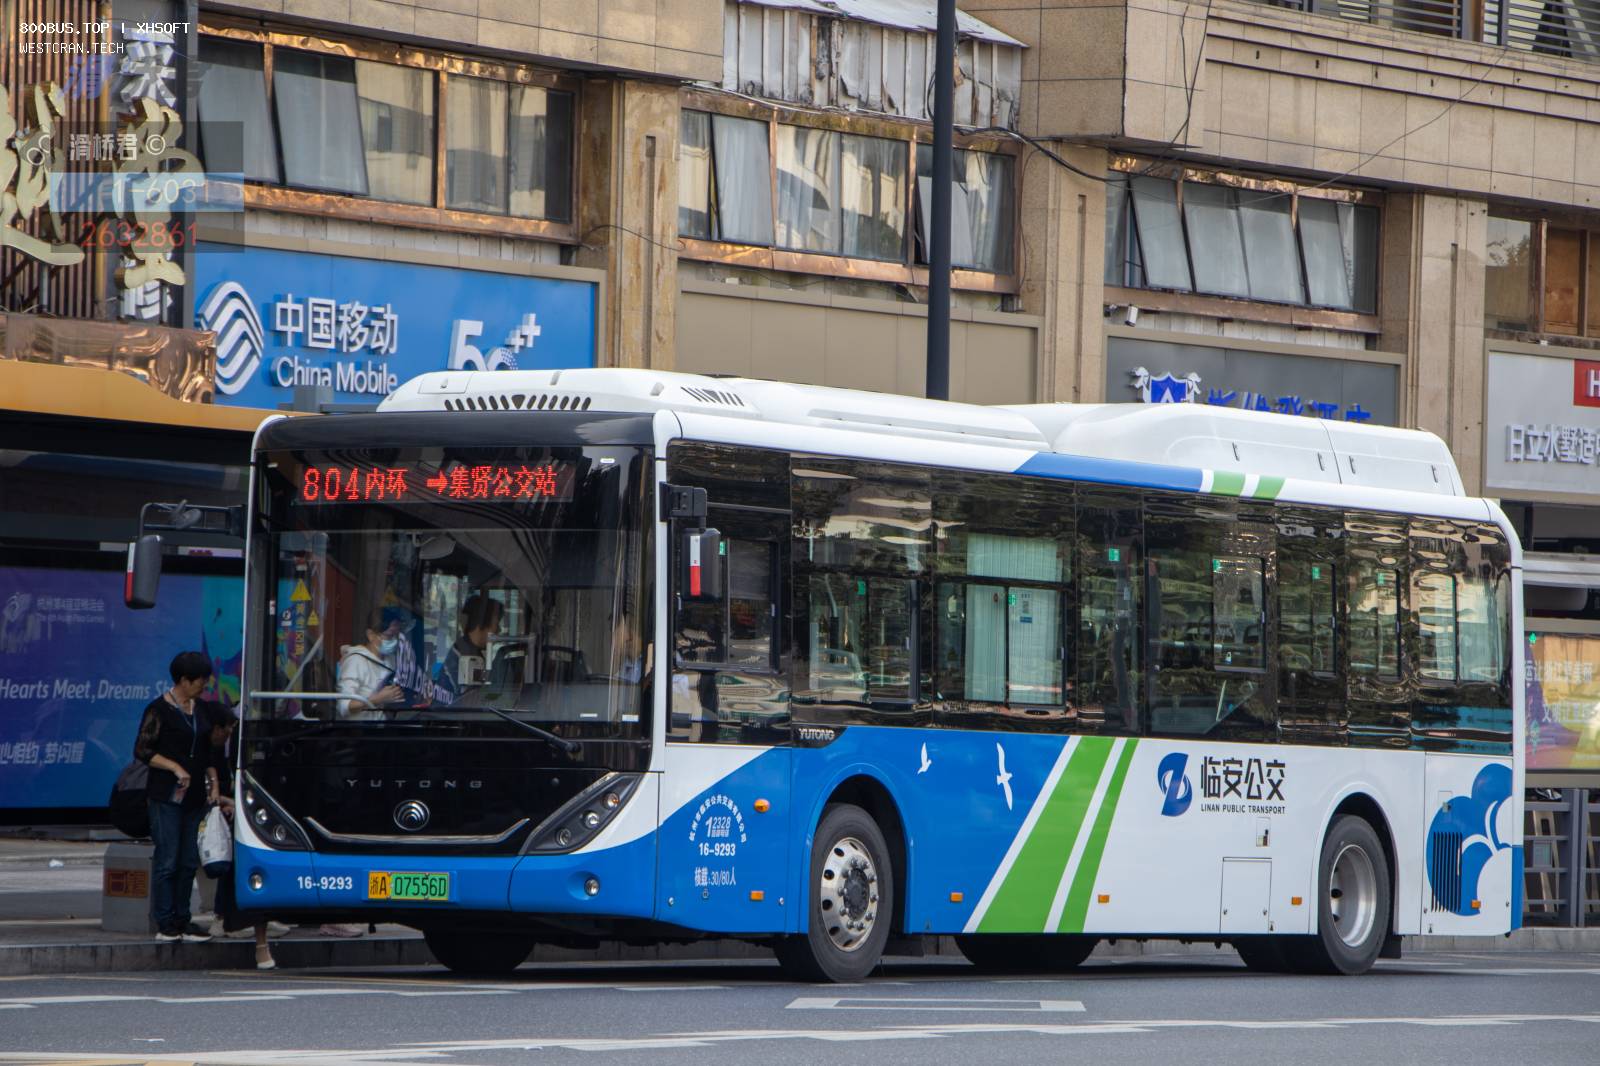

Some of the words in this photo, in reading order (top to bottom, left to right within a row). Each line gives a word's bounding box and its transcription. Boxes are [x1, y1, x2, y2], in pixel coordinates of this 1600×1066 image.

[274, 294, 399, 355] 中国移动
[276, 355, 333, 388] China
[335, 359, 398, 394] Mobile
[449, 465, 557, 499] 集贤公交站
[0, 679, 49, 699] Hearts
[799, 728, 835, 740] YUTONG
[345, 779, 483, 789] YUTONG
[1200, 756, 1286, 801] 临安公交
[1222, 804, 1246, 813] PUBLIC
[1248, 805, 1286, 815] TRANSPORT
[698, 843, 736, 856] 16-9293
